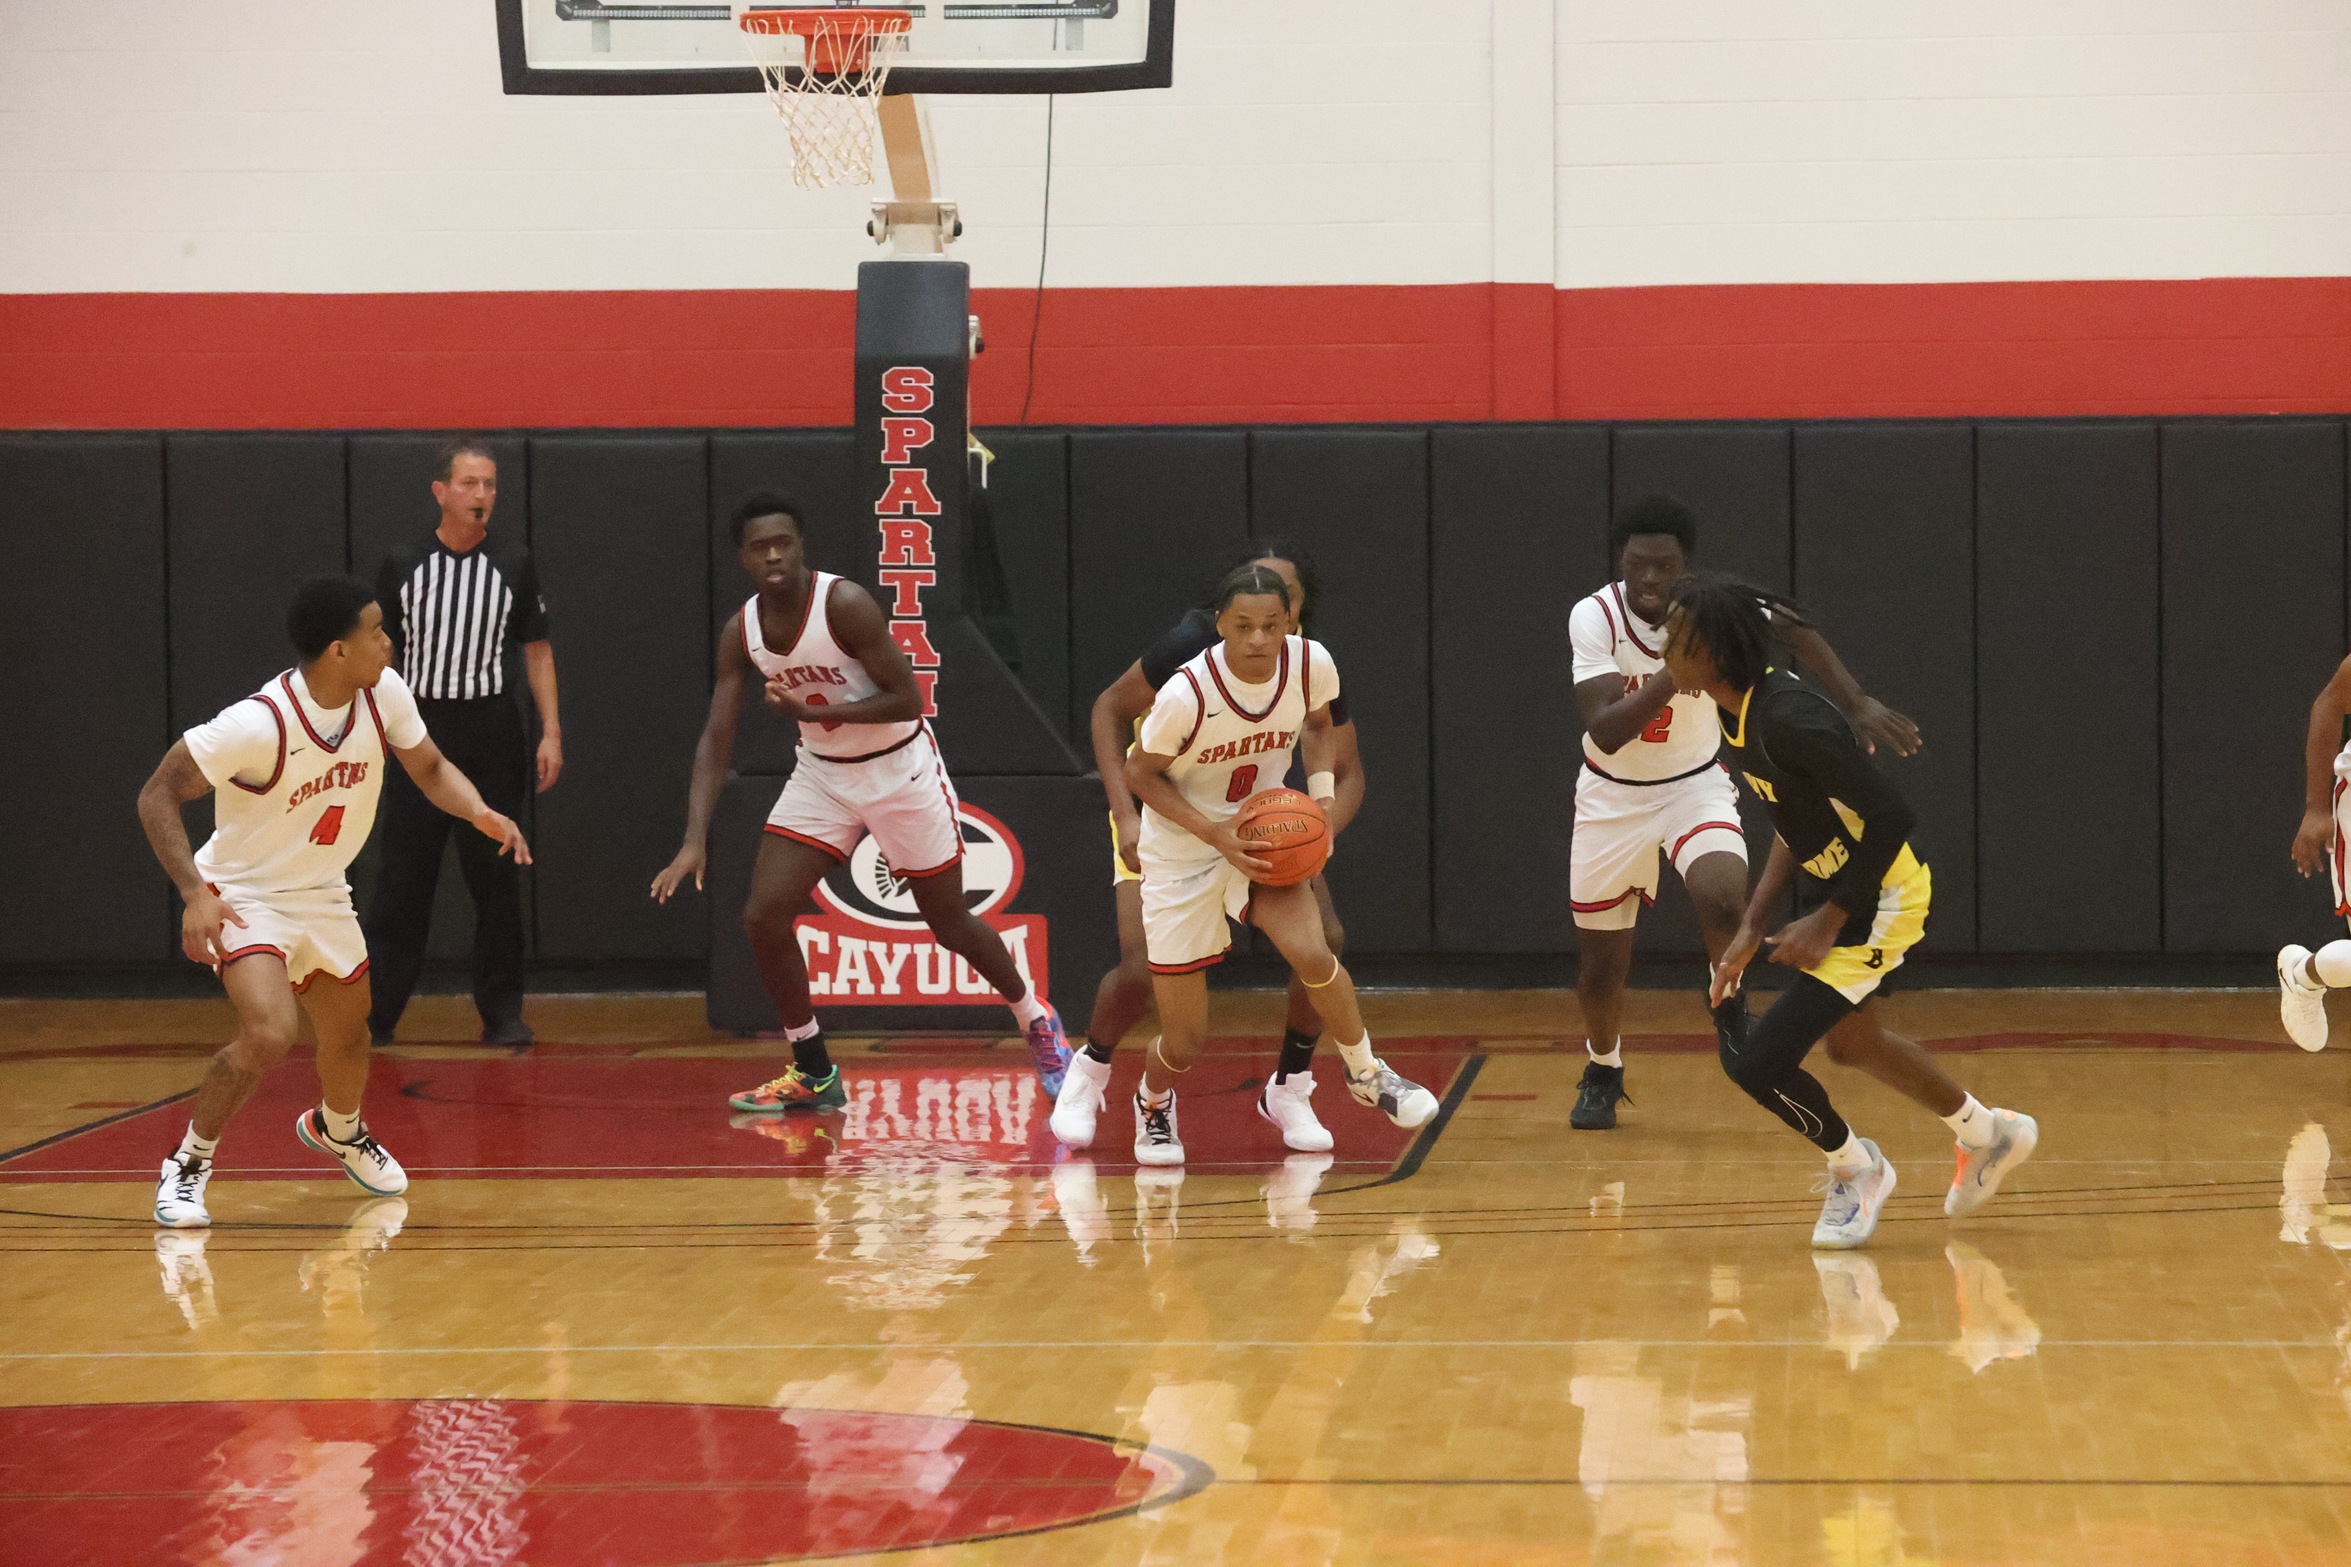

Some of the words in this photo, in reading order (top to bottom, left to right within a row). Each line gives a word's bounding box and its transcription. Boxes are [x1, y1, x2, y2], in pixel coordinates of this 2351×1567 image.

[1226, 764, 1258, 803] 0
[309, 804, 346, 845] 4
[1245, 819, 1309, 841] SPALDING
[1863, 948, 1884, 969] B
